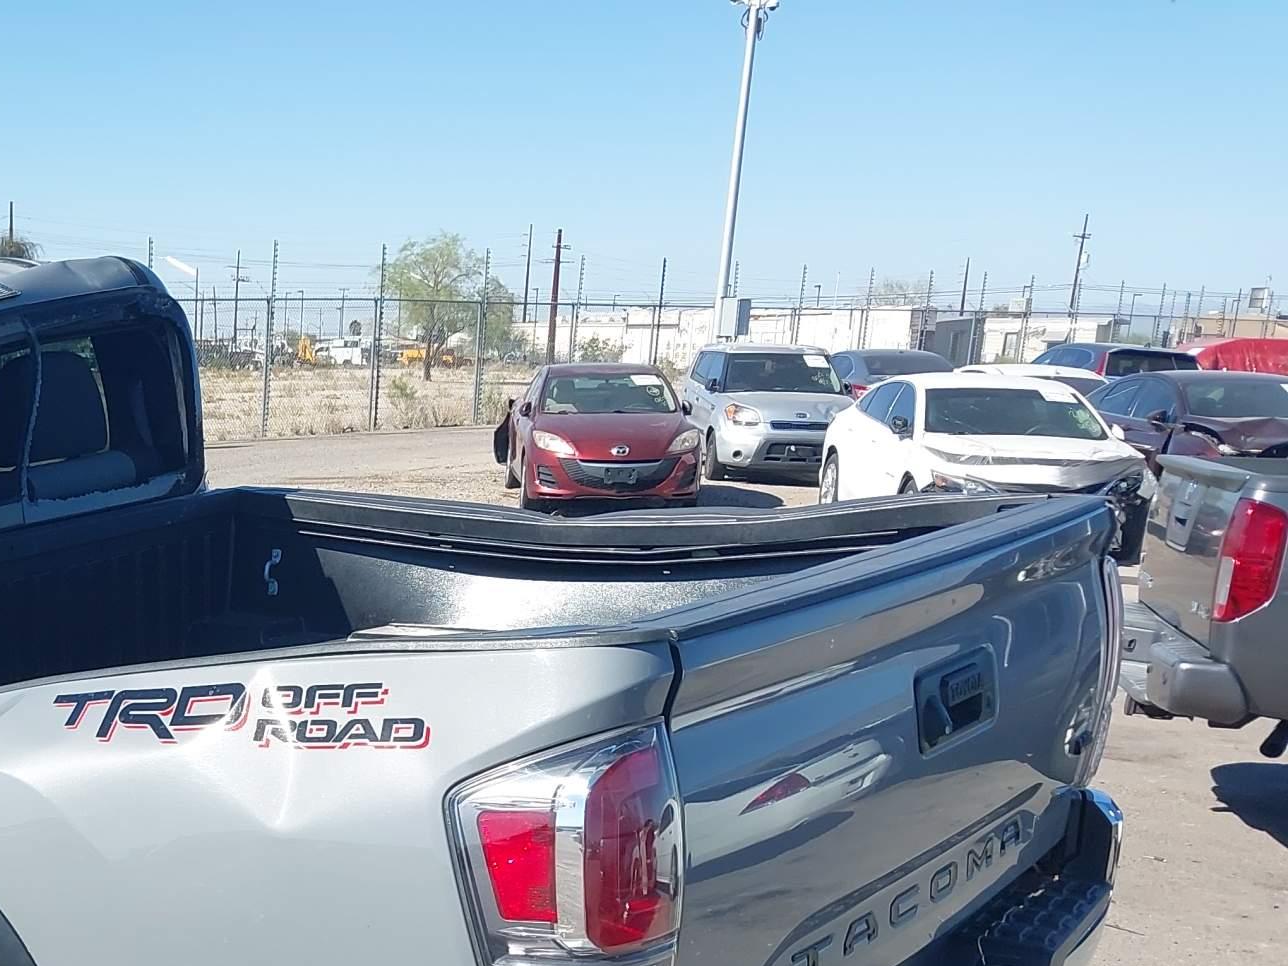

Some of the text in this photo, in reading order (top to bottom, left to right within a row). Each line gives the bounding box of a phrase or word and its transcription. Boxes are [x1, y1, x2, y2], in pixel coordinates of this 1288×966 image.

[53, 682, 389, 743] TRD OFF
[252, 717, 431, 749] ROAD
